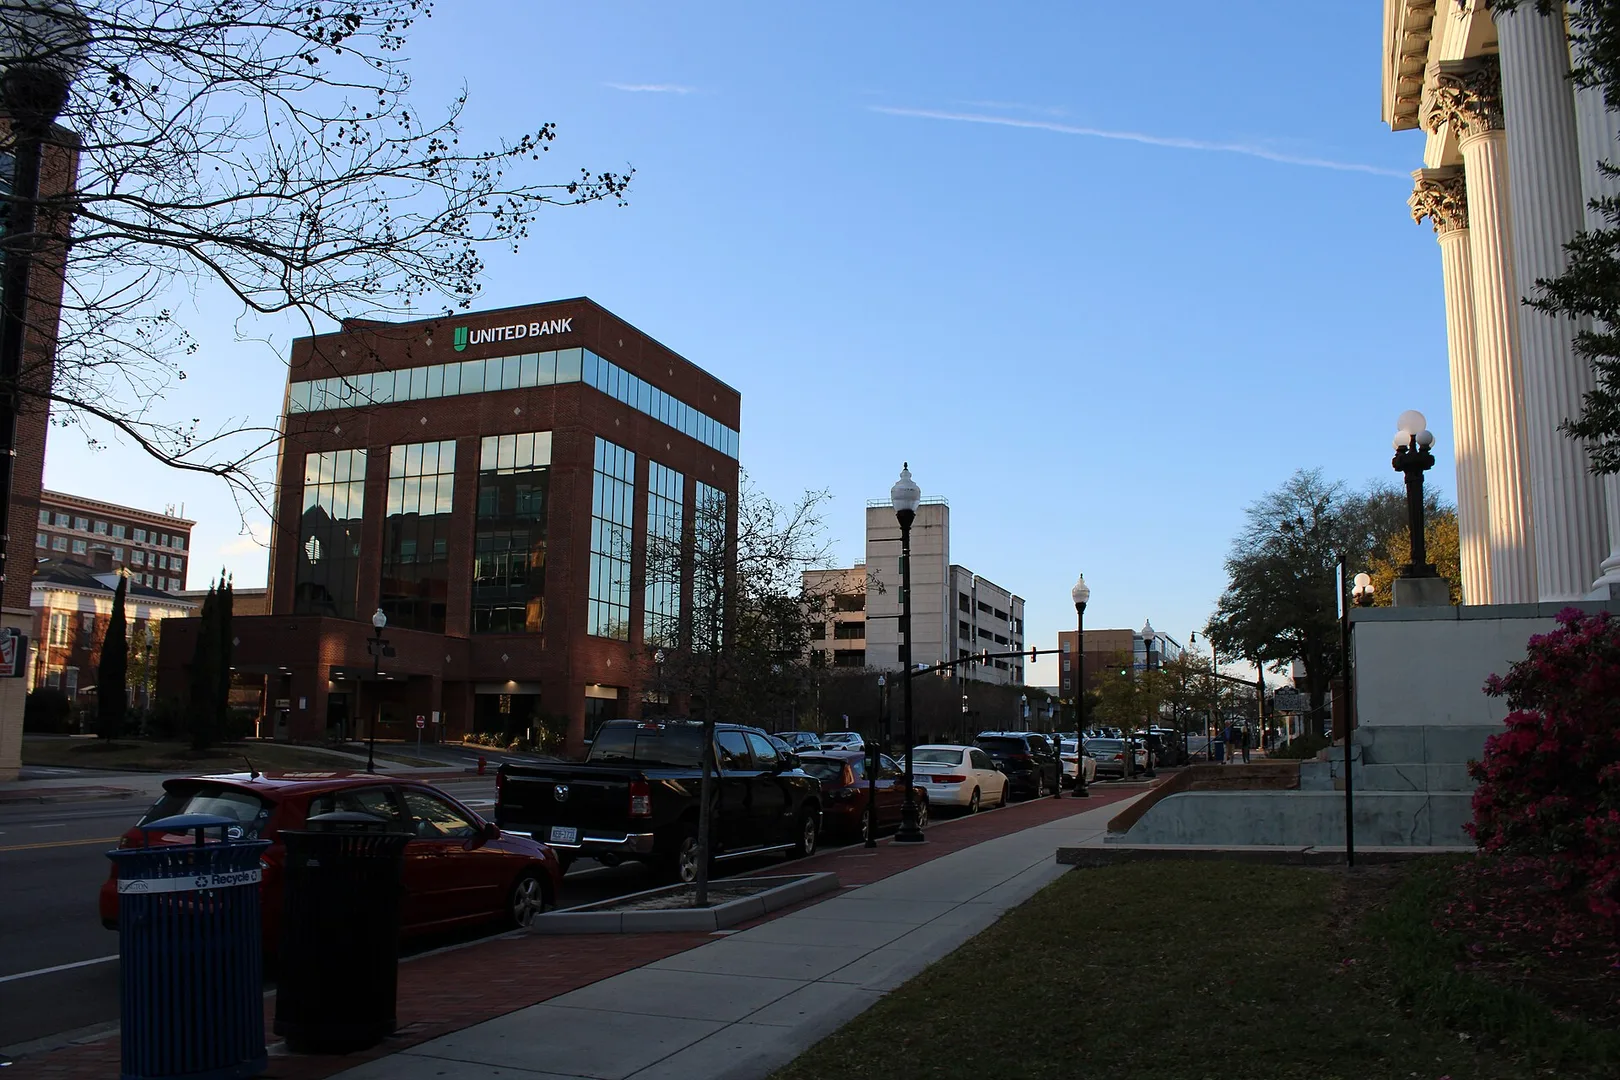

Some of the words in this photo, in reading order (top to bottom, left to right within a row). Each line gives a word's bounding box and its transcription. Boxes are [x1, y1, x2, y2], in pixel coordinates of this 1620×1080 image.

[469, 324, 527, 344] UNITED
[529, 317, 573, 337] BANK
[211, 871, 250, 886] Recycle
